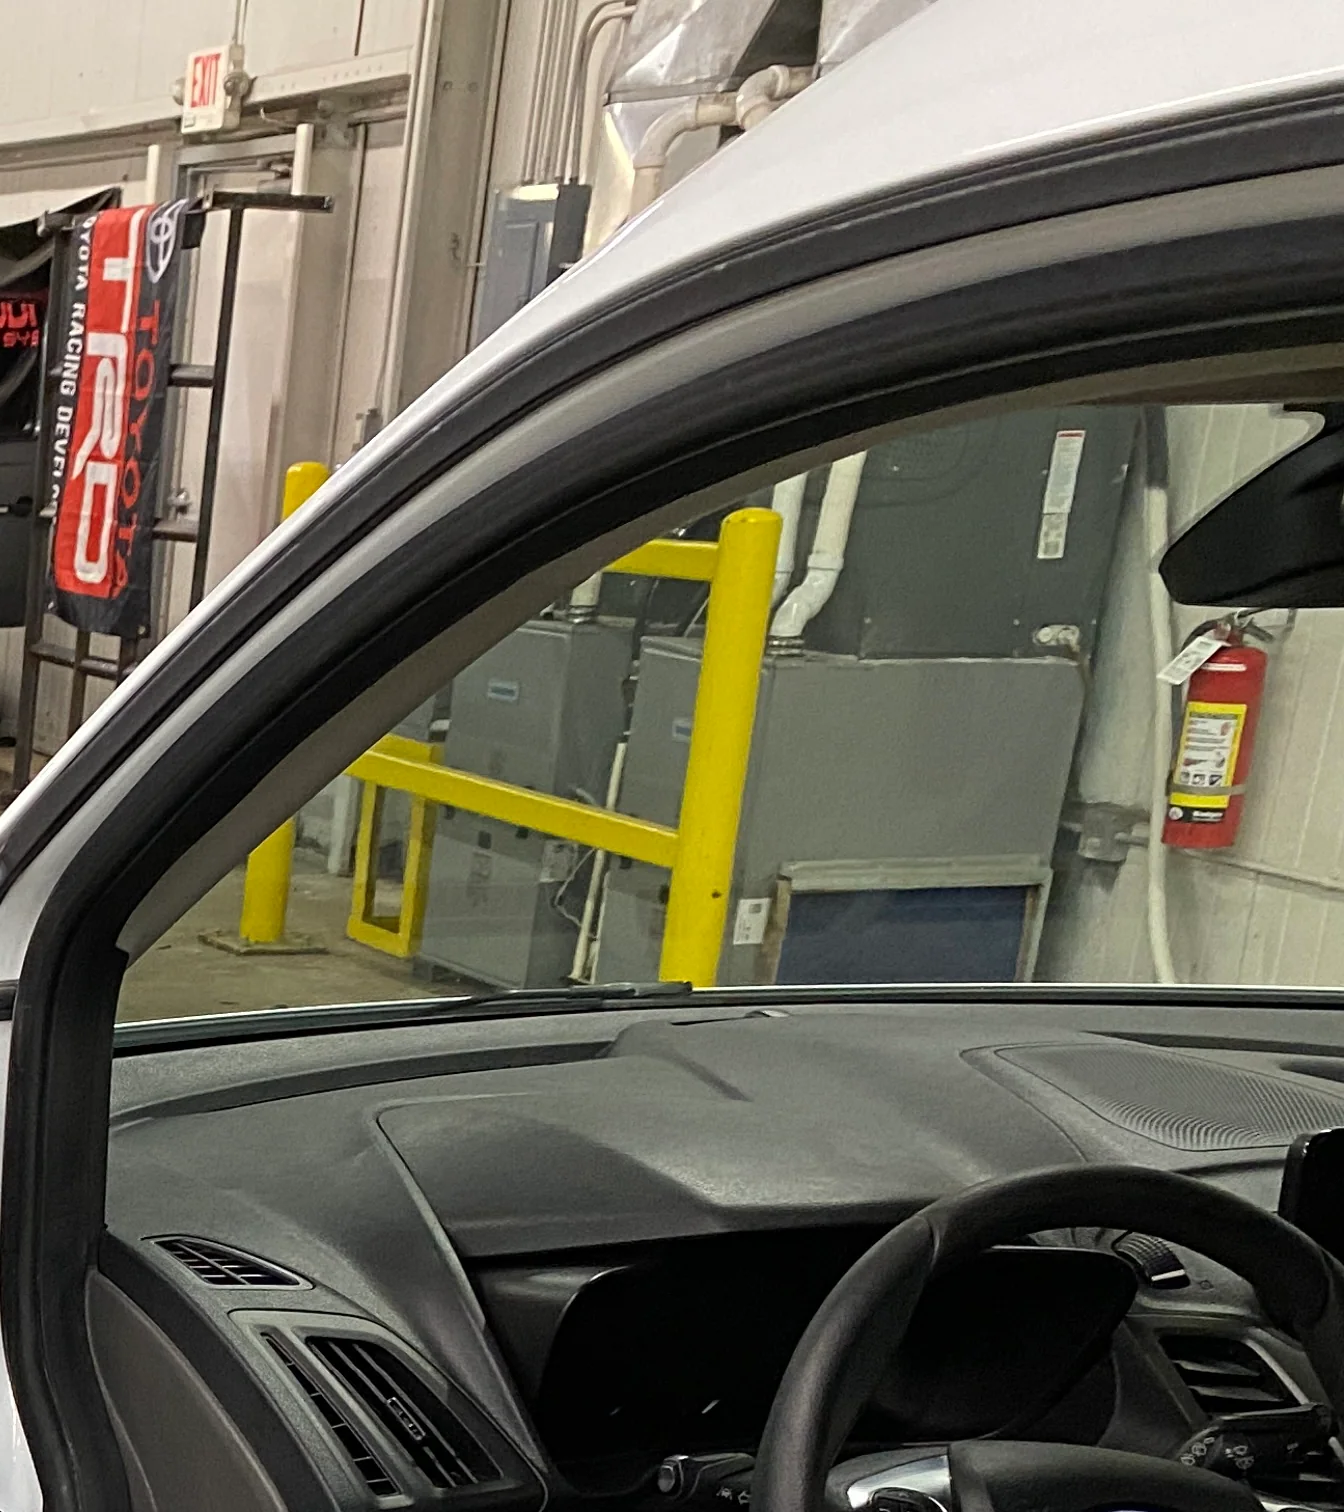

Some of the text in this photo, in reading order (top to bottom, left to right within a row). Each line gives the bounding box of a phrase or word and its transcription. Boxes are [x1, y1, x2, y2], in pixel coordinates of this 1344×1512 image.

[191, 53, 221, 108] EXIT
[75, 215, 98, 291] OYOTA
[60, 303, 87, 397] RACING
[72, 208, 148, 584] TRD
[112, 299, 161, 599] TOYOTA
